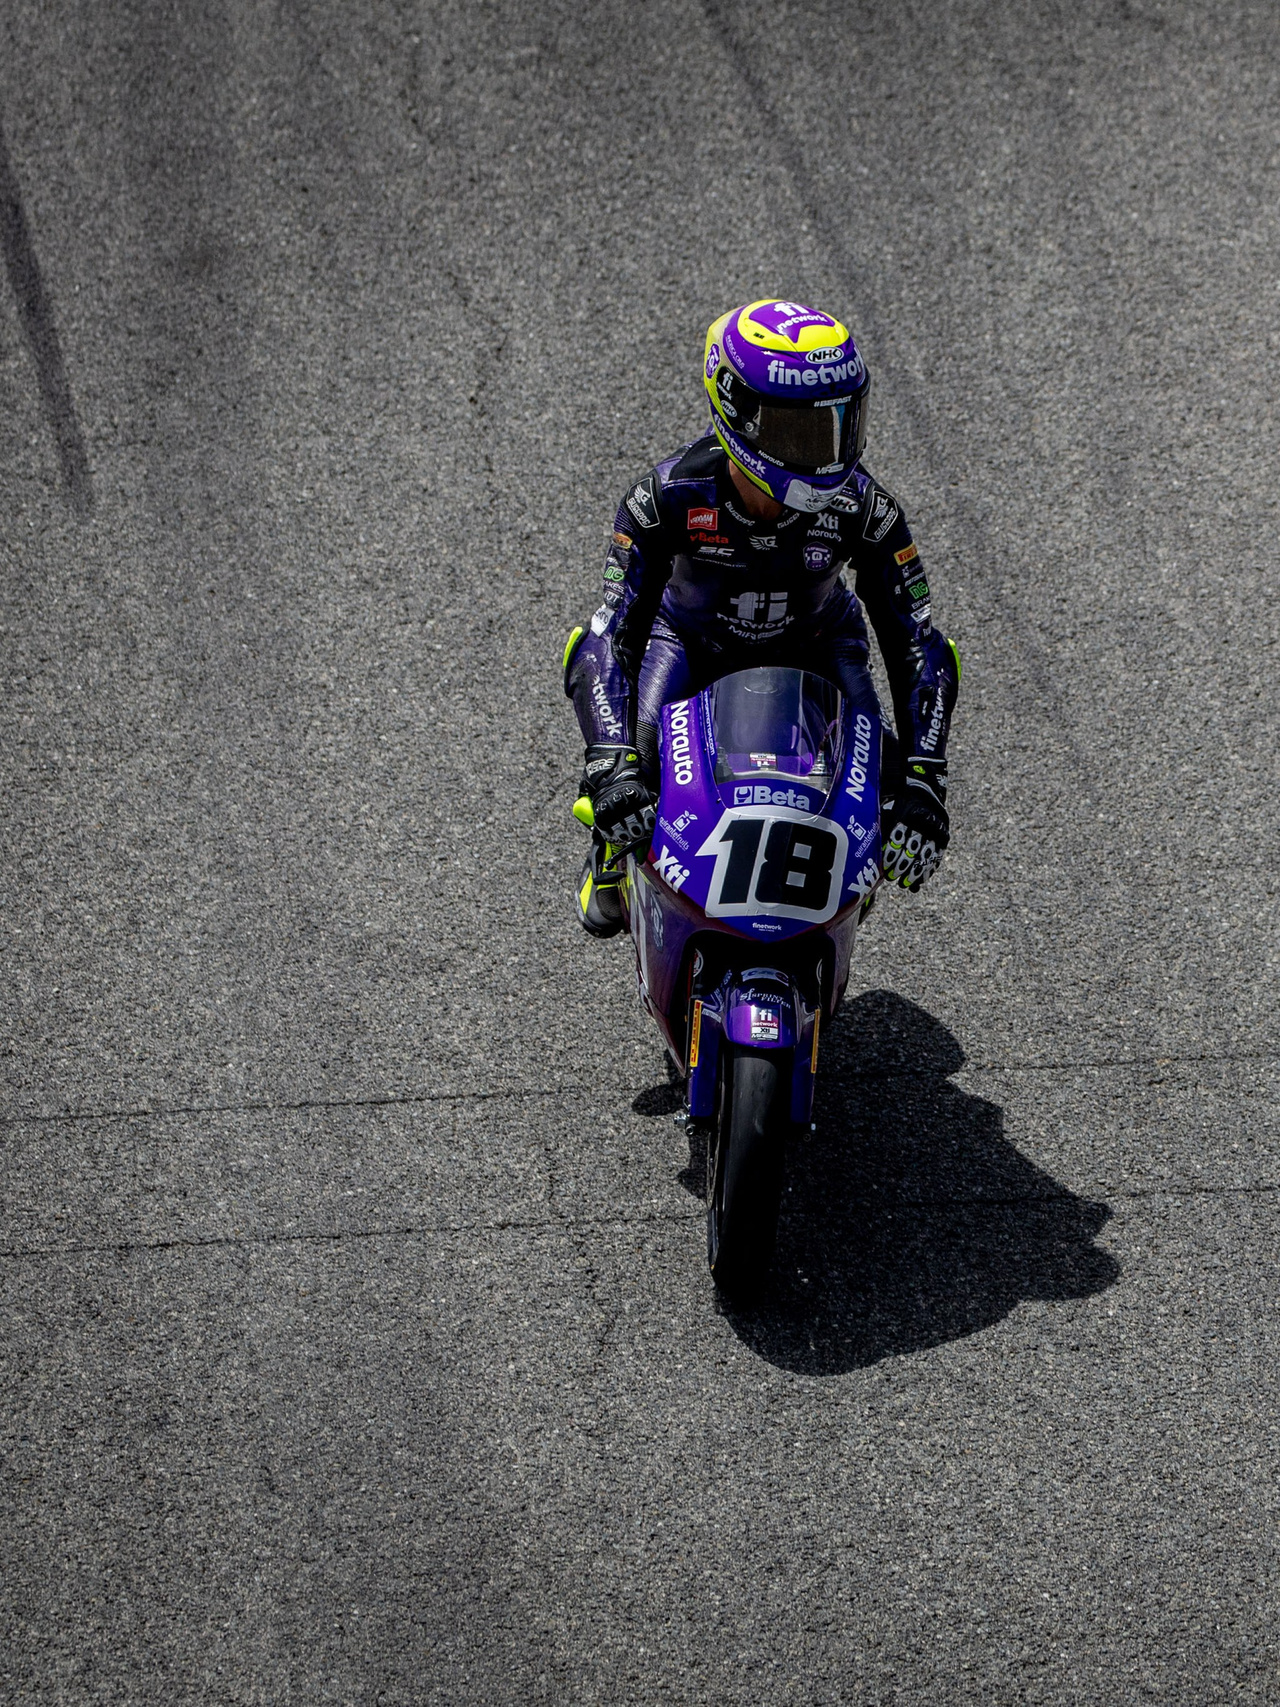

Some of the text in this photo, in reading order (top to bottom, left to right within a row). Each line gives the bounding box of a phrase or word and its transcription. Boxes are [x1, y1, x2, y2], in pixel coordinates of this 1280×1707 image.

[777, 315, 828, 331] network
[714, 413, 766, 475] finetwork
[758, 450, 785, 467] Norauto
[814, 512, 839, 531] Xti
[698, 532, 729, 544] Beta
[807, 529, 842, 542] Norauto
[717, 612, 795, 629] network
[670, 700, 694, 786] Norauto
[845, 714, 872, 802] Norauto
[753, 786, 810, 811] Beta
[652, 845, 690, 894] Xti
[719, 819, 838, 911] 18
[847, 858, 880, 902] Xti
[752, 922, 782, 931] finetwork
[759, 1009, 773, 1021] fi
